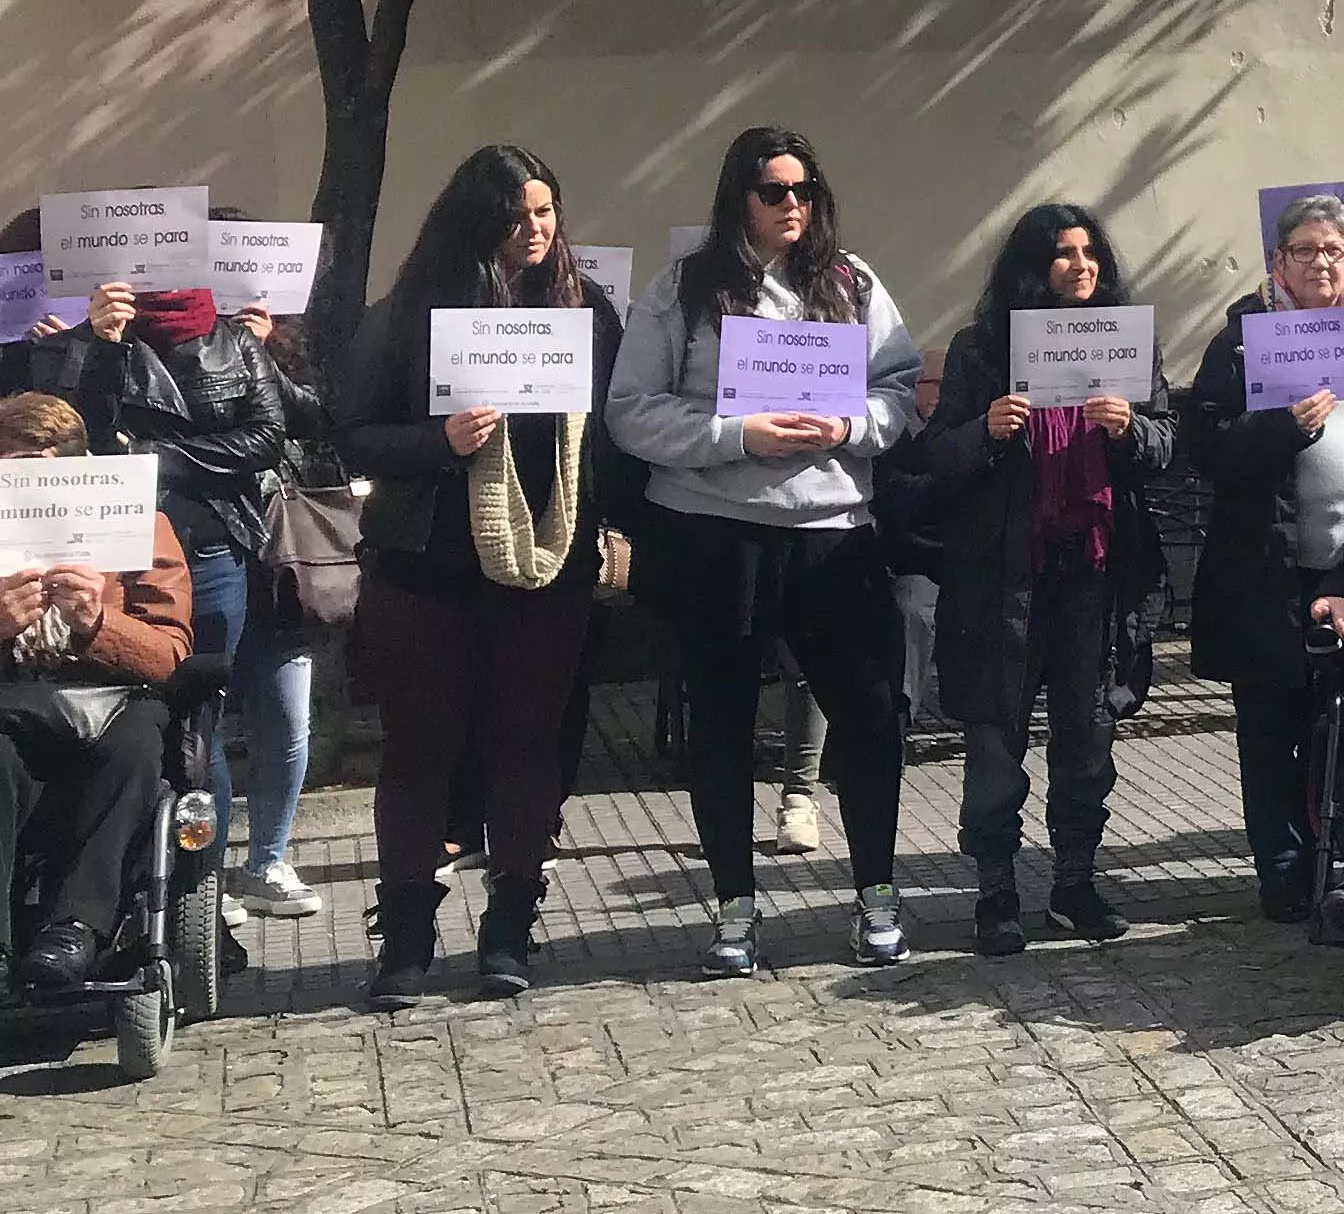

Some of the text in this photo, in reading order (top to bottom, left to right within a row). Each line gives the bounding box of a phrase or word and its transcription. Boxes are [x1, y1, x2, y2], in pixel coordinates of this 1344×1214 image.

[80, 204, 101, 220] Sin
[60, 230, 189, 251] el mundo se para
[219, 231, 238, 247] Sin
[277, 262, 304, 275] para
[471, 319, 492, 336] Sin
[1046, 320, 1064, 335] Sin
[1274, 322, 1291, 337] Sin
[756, 329, 774, 344] Sin
[450, 349, 574, 367] el mundo se para
[1027, 347, 1138, 364] el mundo se para
[1274, 347, 1315, 364] mundo
[736, 356, 850, 378] el mundo se para
[0, 473, 31, 489] Sin
[99, 503, 144, 521] para
